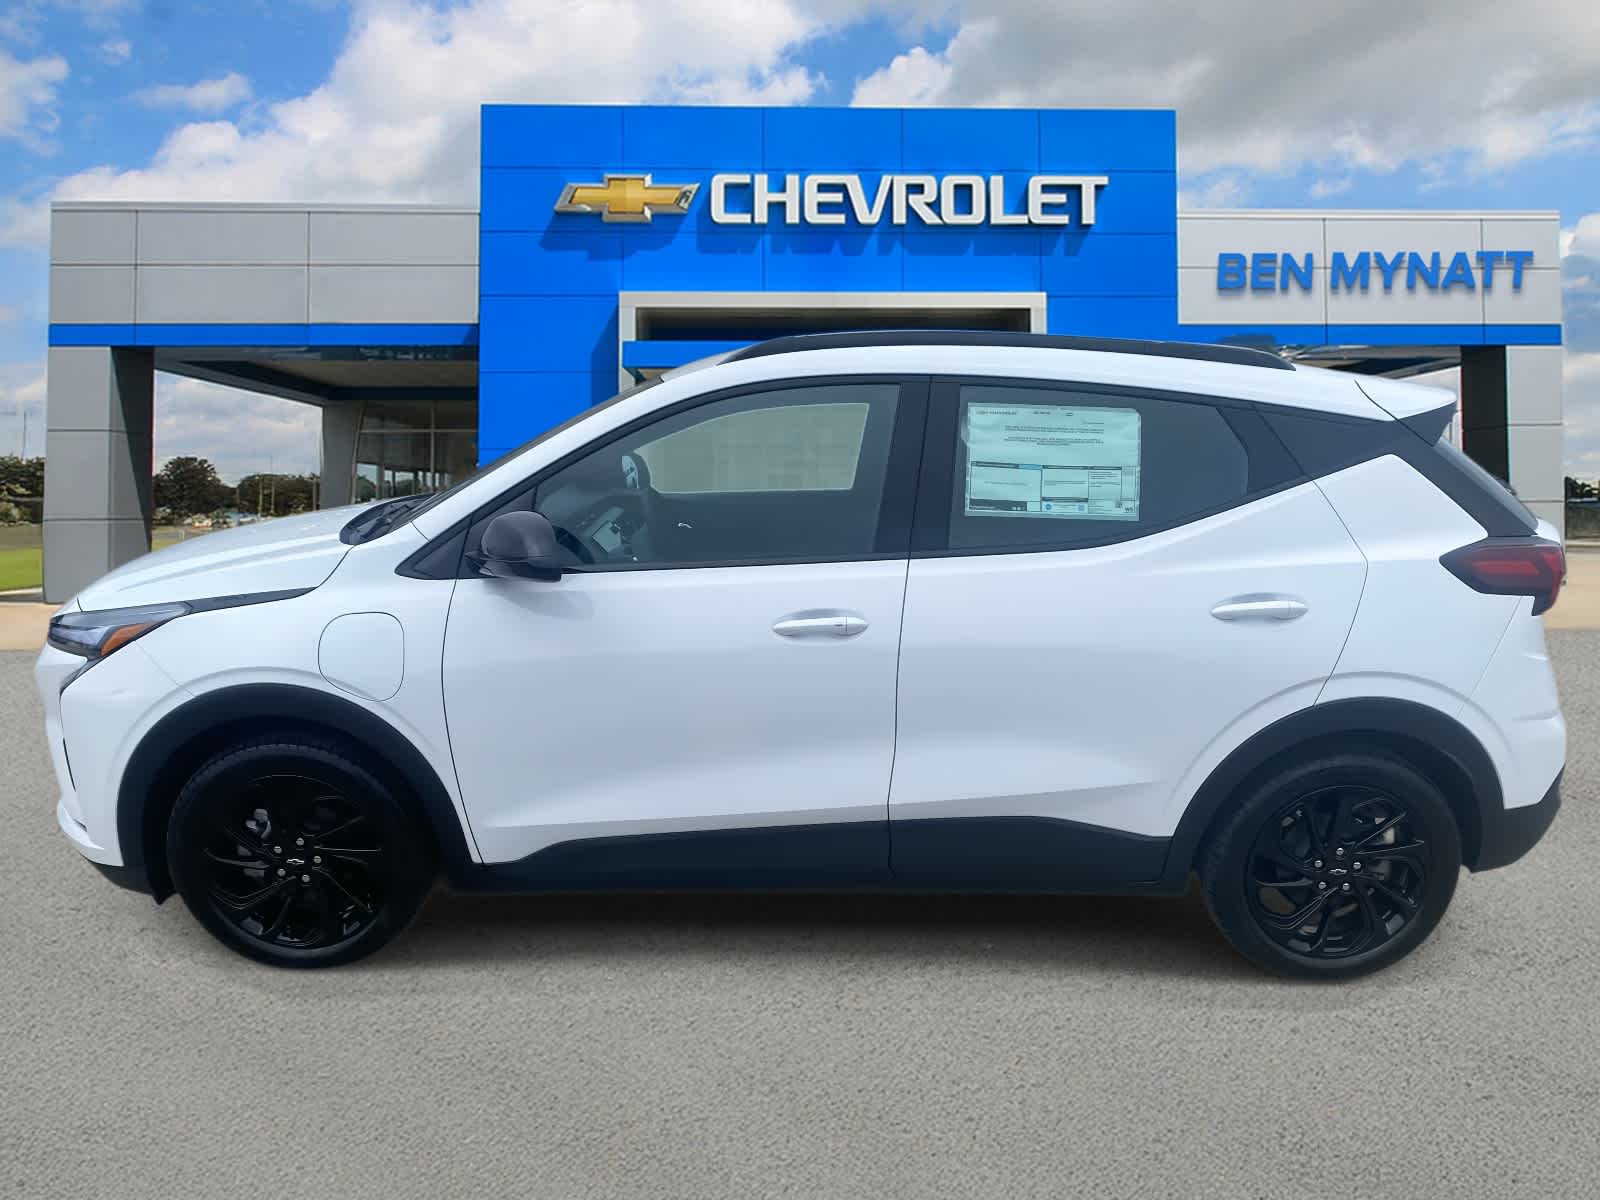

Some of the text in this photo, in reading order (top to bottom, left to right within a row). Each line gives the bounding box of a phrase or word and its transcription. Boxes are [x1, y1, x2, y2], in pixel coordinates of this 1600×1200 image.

[710, 174, 1109, 226] CHEVROLET
[1217, 251, 1534, 291] BEN MYNATT
